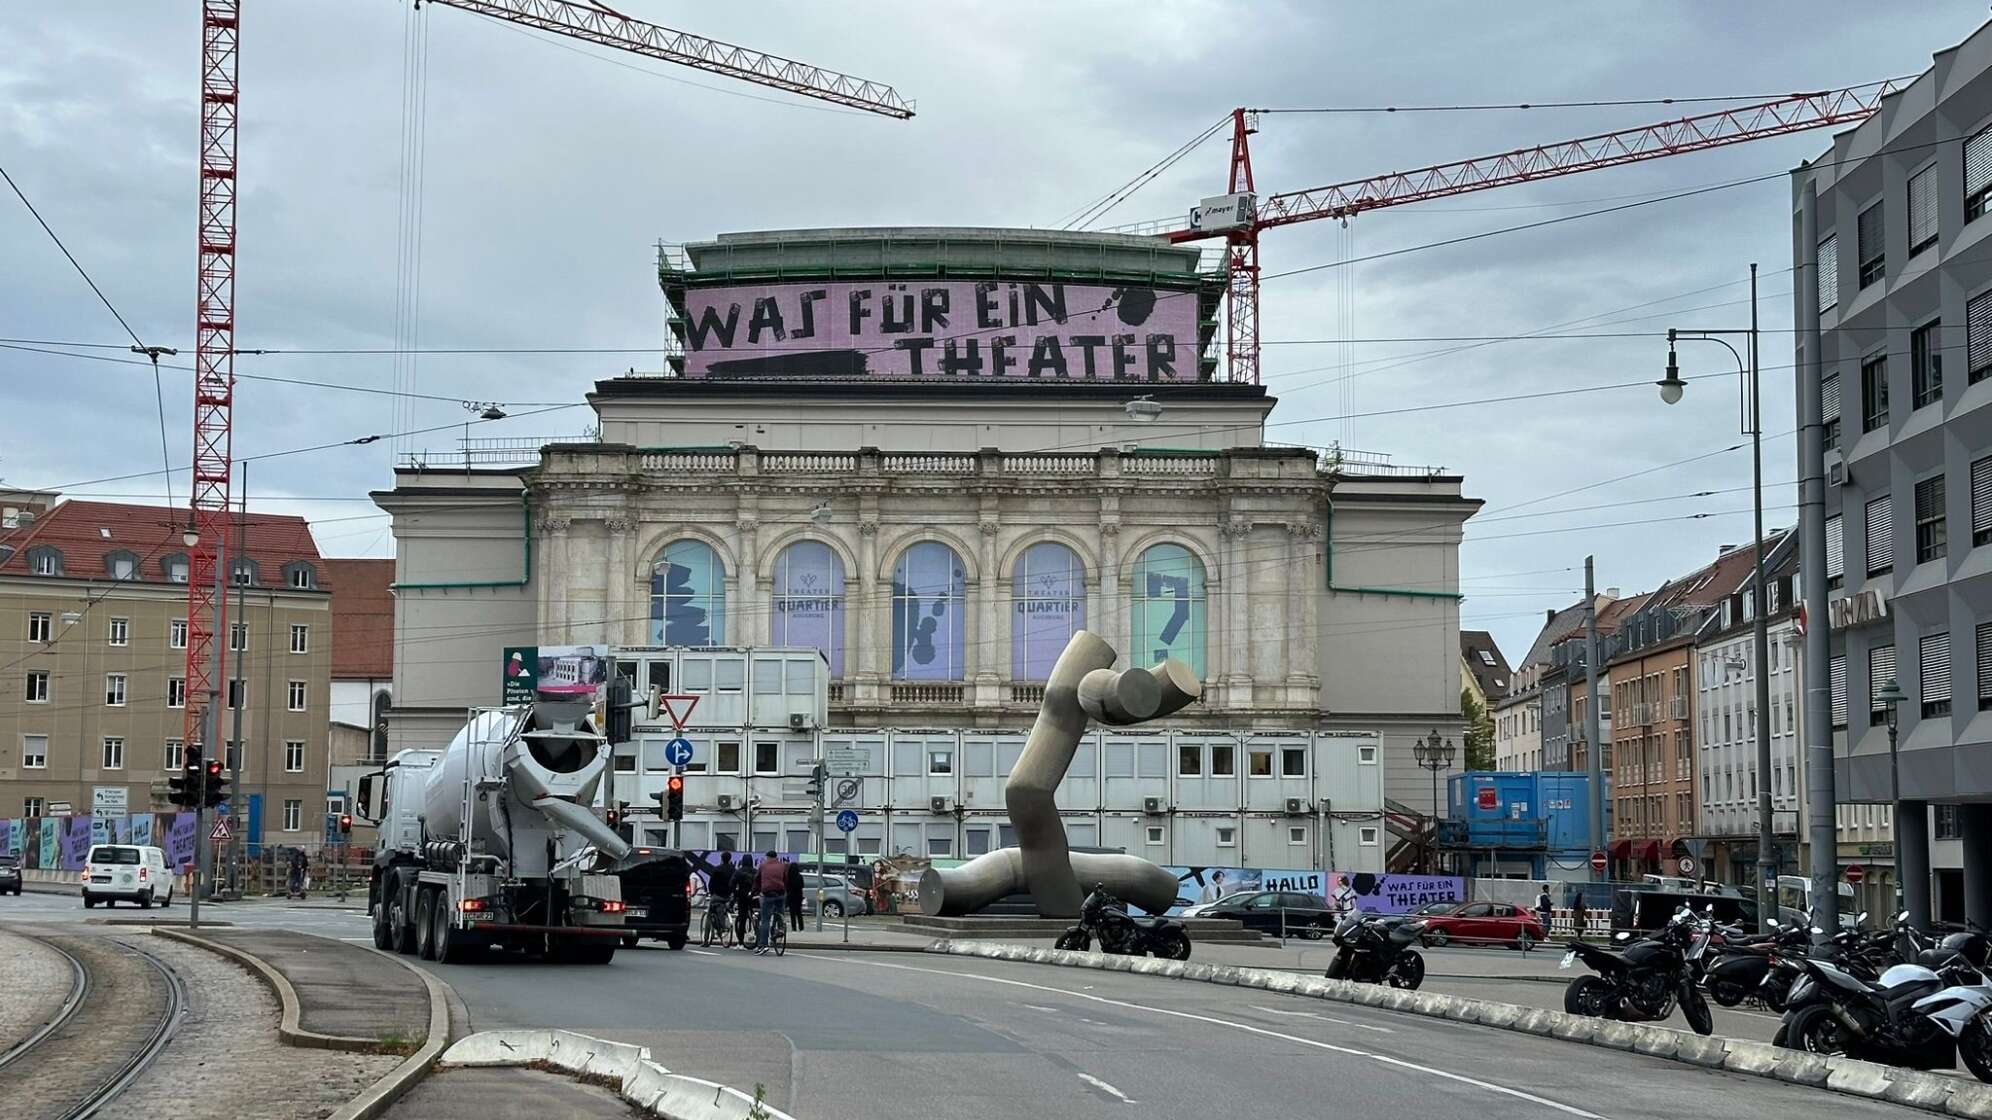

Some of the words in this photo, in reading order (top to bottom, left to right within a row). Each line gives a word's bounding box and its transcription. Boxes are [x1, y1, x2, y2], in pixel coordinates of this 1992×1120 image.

[687, 289, 826, 352] WAS
[850, 284, 950, 335] FÜR
[894, 334, 1177, 381] THEATER
[841, 785, 854, 795] 30
[1265, 875, 1319, 891] HALLO
[1387, 881, 1413, 892] WAS
[1417, 880, 1434, 891] FÜR
[1386, 891, 1456, 907] THEATER
